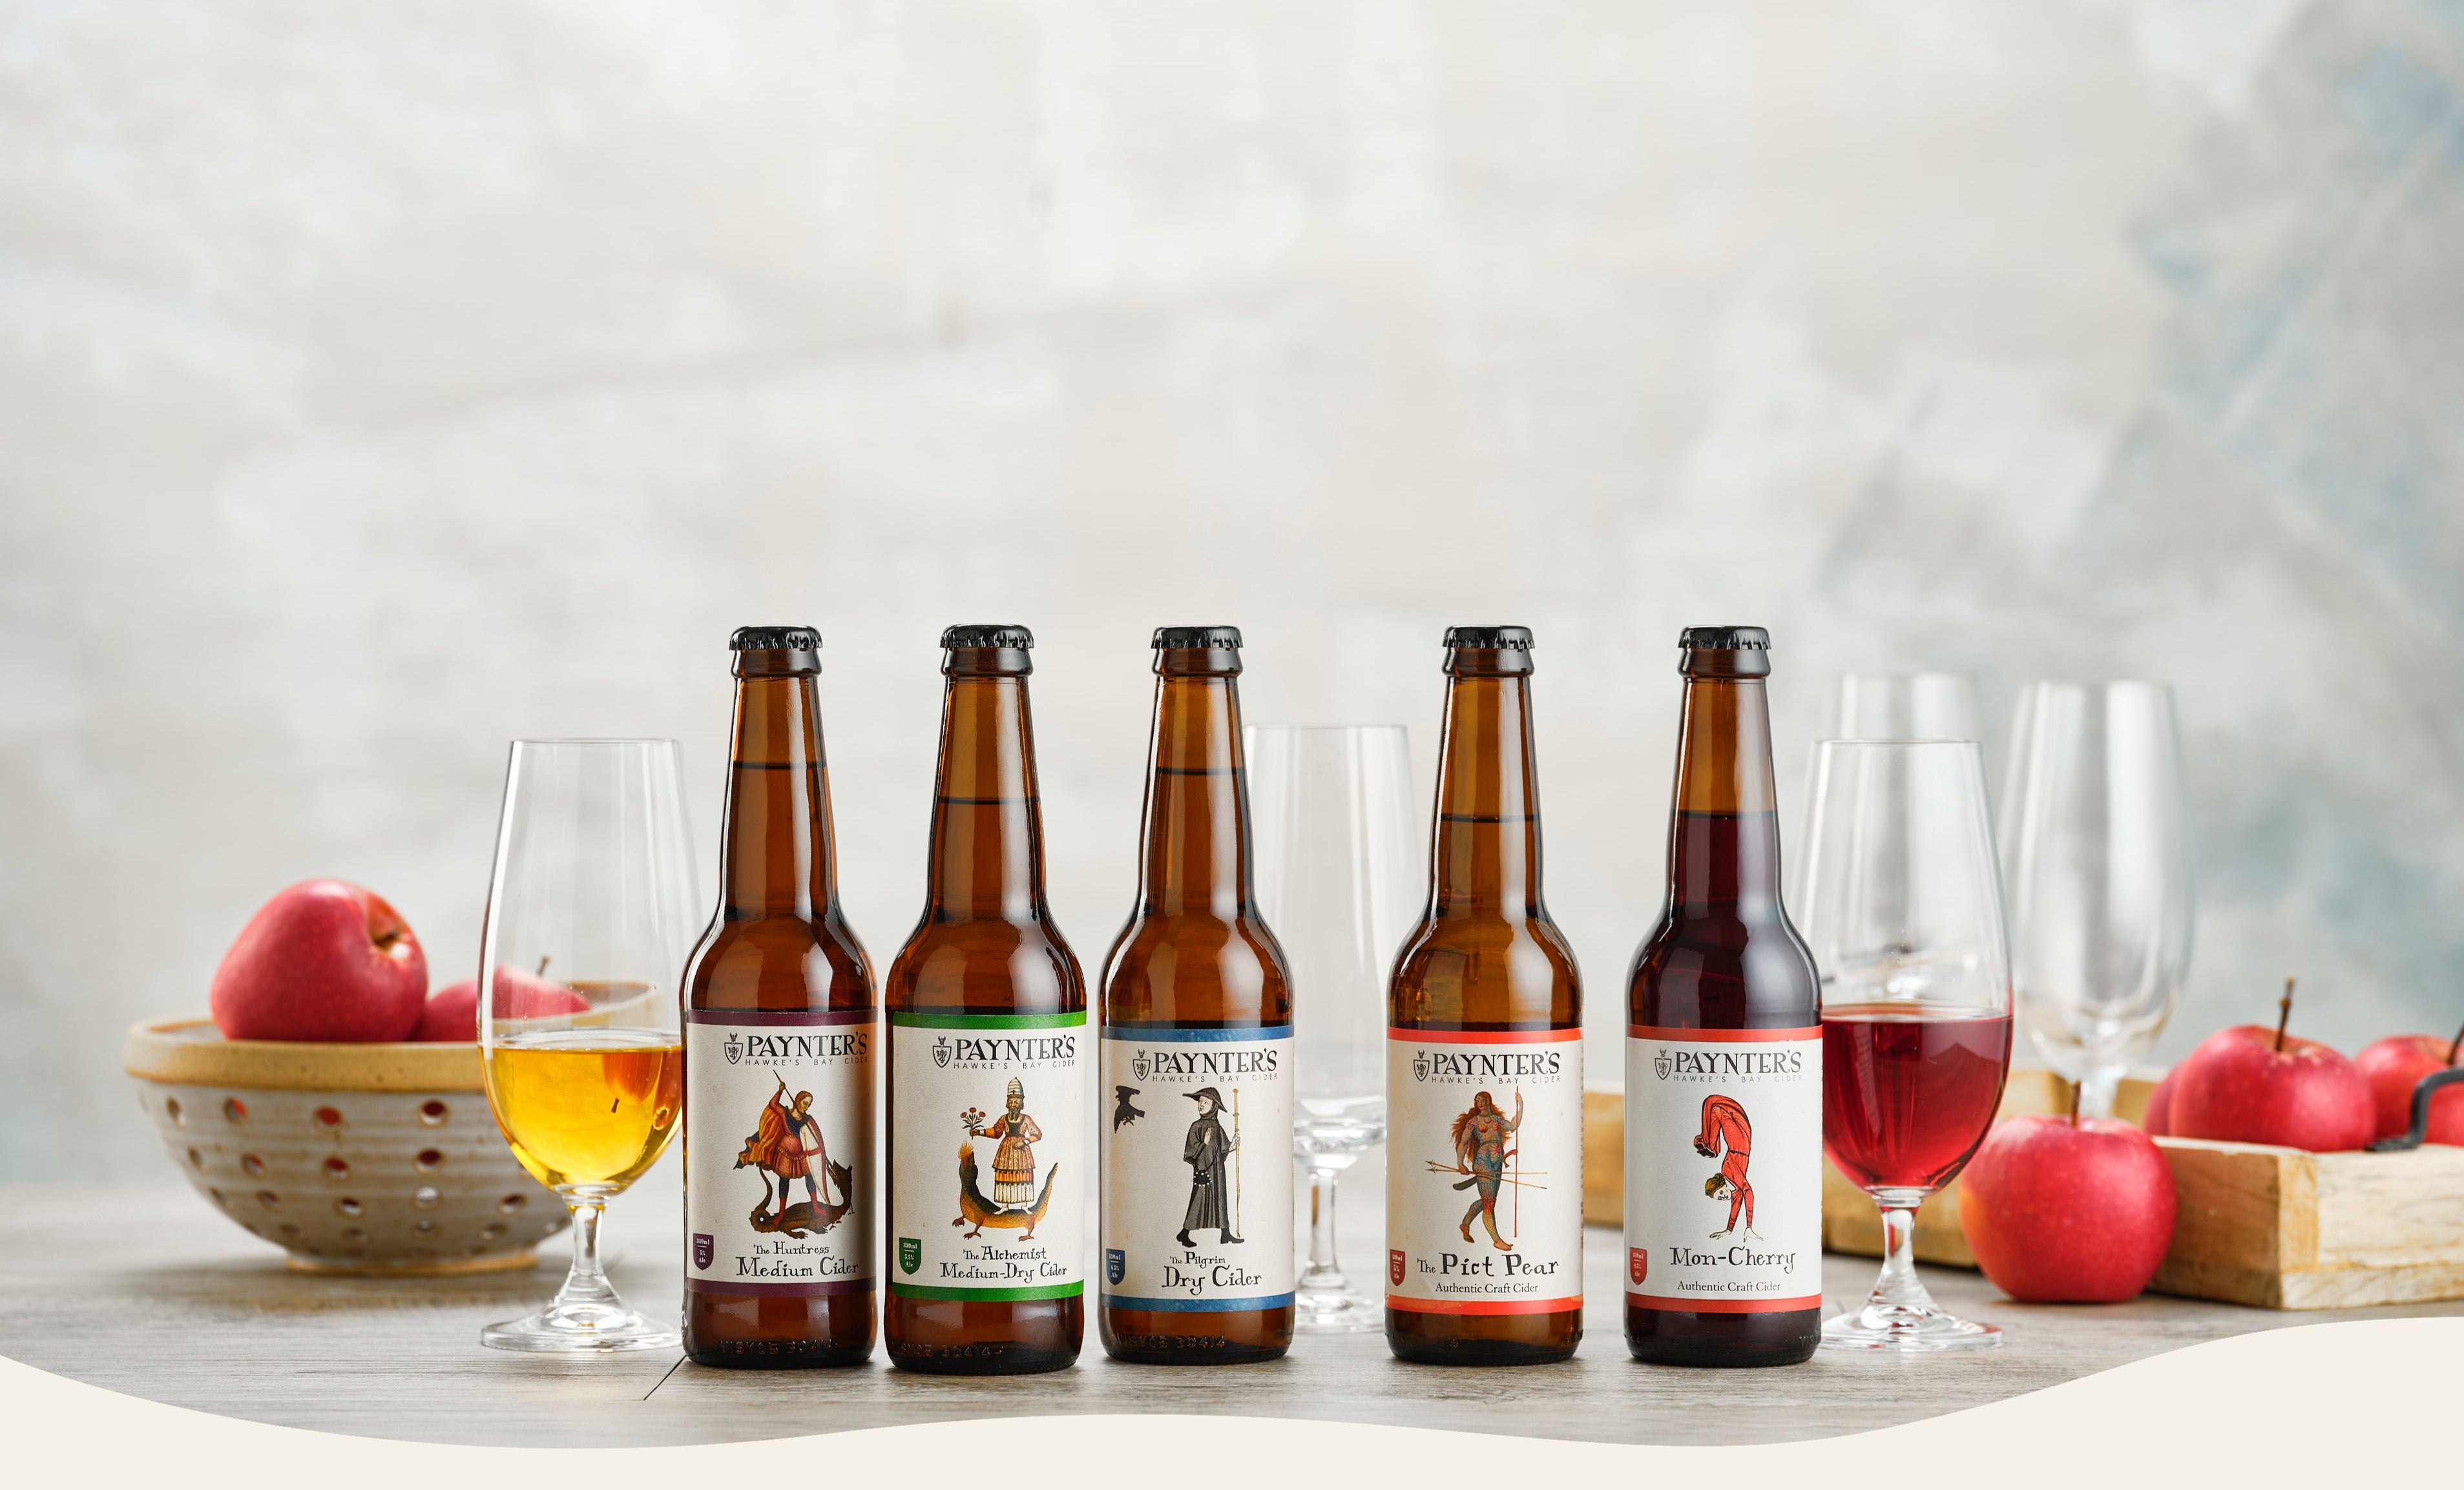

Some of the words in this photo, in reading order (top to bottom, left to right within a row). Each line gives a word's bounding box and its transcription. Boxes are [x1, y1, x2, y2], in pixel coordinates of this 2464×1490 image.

[747, 1032, 867, 1058] PAYNTER'S
[955, 1035, 1075, 1061] PAYNTER'S
[844, 1056, 868, 1065] CIDER
[1154, 1049, 1277, 1075] PAYNTER'S
[1433, 1051, 1560, 1075] PAYNTER'S
[1675, 1049, 1802, 1075] PAYNTER'S
[753, 1244, 769, 1254] The
[773, 1241, 830, 1254] Huntress
[963, 1249, 979, 1259] The
[982, 1246, 1047, 1260] Alchemist
[736, 1257, 813, 1276] Medium
[820, 1255, 859, 1276] Cider
[1170, 1255, 1182, 1264] The
[1184, 1252, 1226, 1268] Pilgrim
[1417, 1257, 1436, 1274] The
[1439, 1252, 1494, 1275] Pict
[1502, 1254, 1558, 1276] Pear
[1670, 1246, 1796, 1274] Mon-Cherry
[940, 1263, 1034, 1283] Medium-Dry
[1040, 1263, 1067, 1277] Cider
[1162, 1266, 1205, 1295] Dry
[1213, 1264, 1262, 1286] Cider
[1435, 1283, 1482, 1294] Authentic
[1485, 1283, 1510, 1294] Craft
[1513, 1283, 1538, 1292] Cider
[1677, 1281, 1725, 1292] Authentic
[1728, 1281, 1754, 1292] Craft
[1756, 1281, 1780, 1291] Cider
